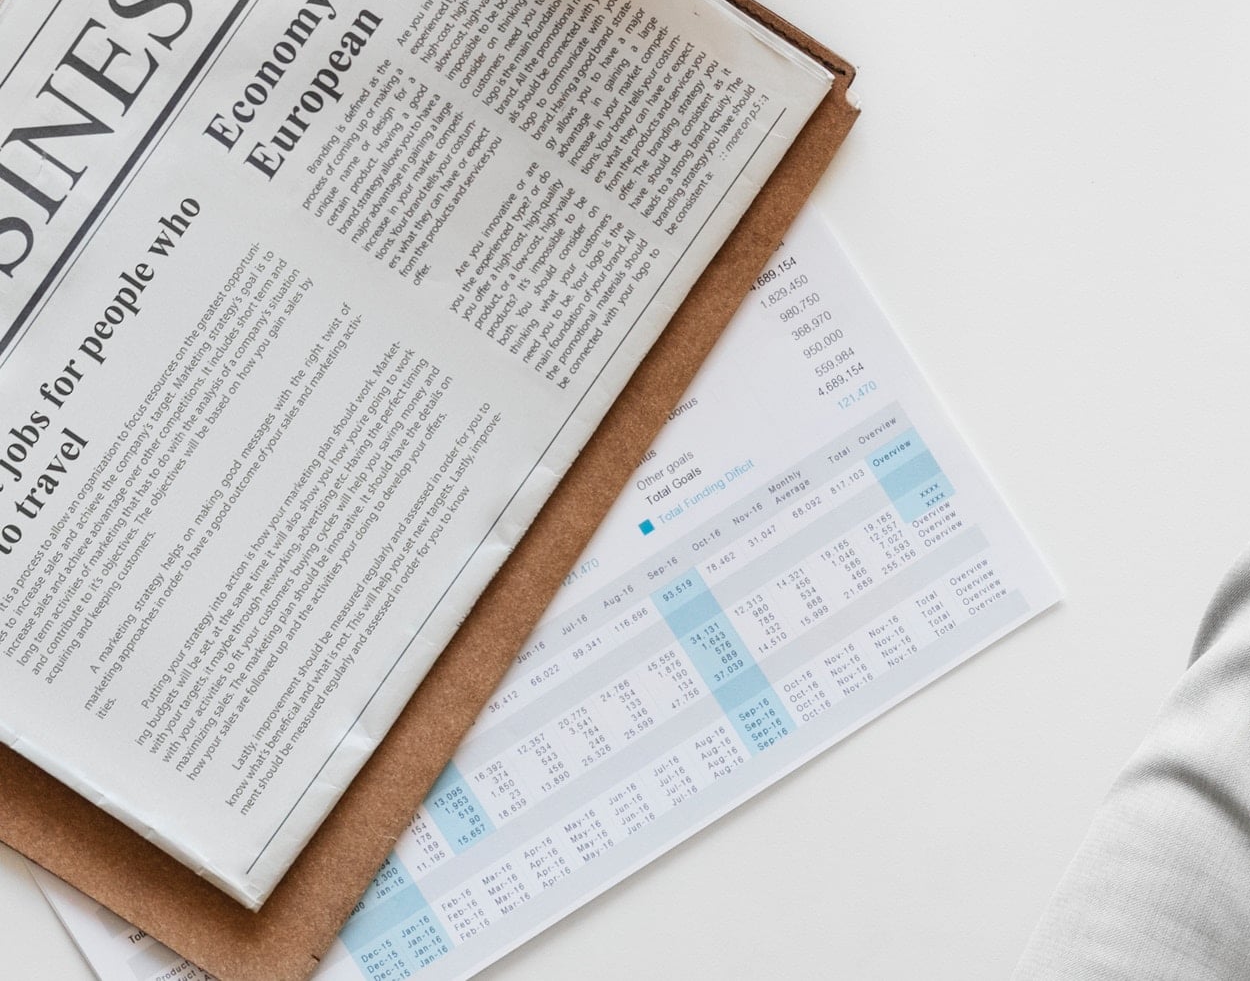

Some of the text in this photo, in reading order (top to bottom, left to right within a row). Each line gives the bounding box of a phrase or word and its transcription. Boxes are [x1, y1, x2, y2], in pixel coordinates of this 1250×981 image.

[242, 8, 384, 182] European
[305, 58, 392, 174] Branding is defined as the
[38, 358, 84, 409] for
[77, 262, 155, 365] people
[146, 197, 201, 257] who
[508, 212, 613, 355] thinking what your customers
[857, 416, 897, 445] Overview
[13, 426, 89, 519] travel
[635, 450, 694, 491] Other goals
[826, 445, 851, 464] Total
[644, 466, 702, 505] Total Goals
[656, 502, 684, 524] Total
[682, 478, 727, 508] Funding
[767, 469, 801, 494] Monthly
[774, 478, 810, 505] Average
[98, 571, 165, 663] marketing strategy
[562, 808, 596, 833] May-16
[440, 887, 472, 912] Feb-16
